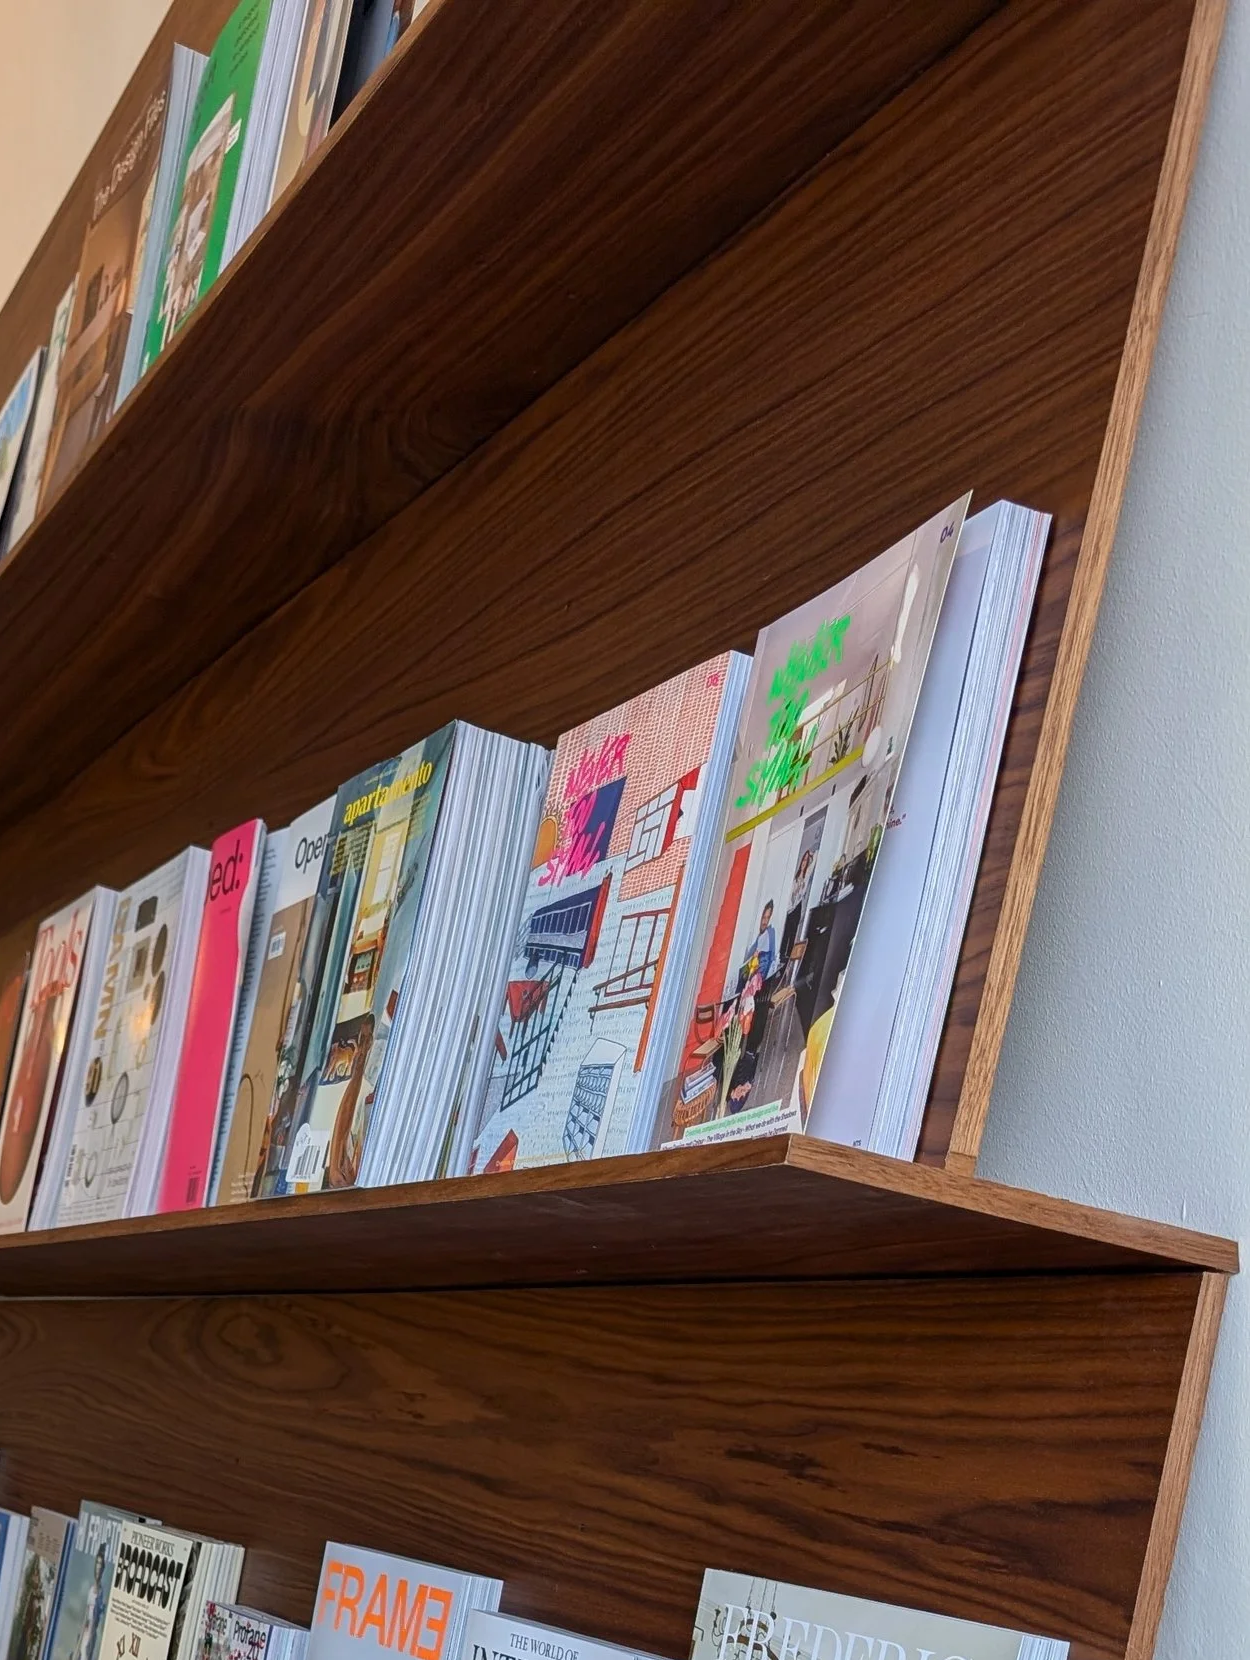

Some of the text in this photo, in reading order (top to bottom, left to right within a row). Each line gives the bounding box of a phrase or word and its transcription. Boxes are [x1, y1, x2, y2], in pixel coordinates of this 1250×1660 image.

[343, 760, 433, 827] apartamento
[564, 733, 631, 798] NEVER
[538, 822, 606, 887] SMALL
[131, 1530, 175, 1557] PIONEER WORKS
[114, 1541, 184, 1612] BROADCAST
[233, 1620, 267, 1649] Profane
[509, 1633, 529, 1651] THE
[530, 1639, 565, 1660] WORLD
